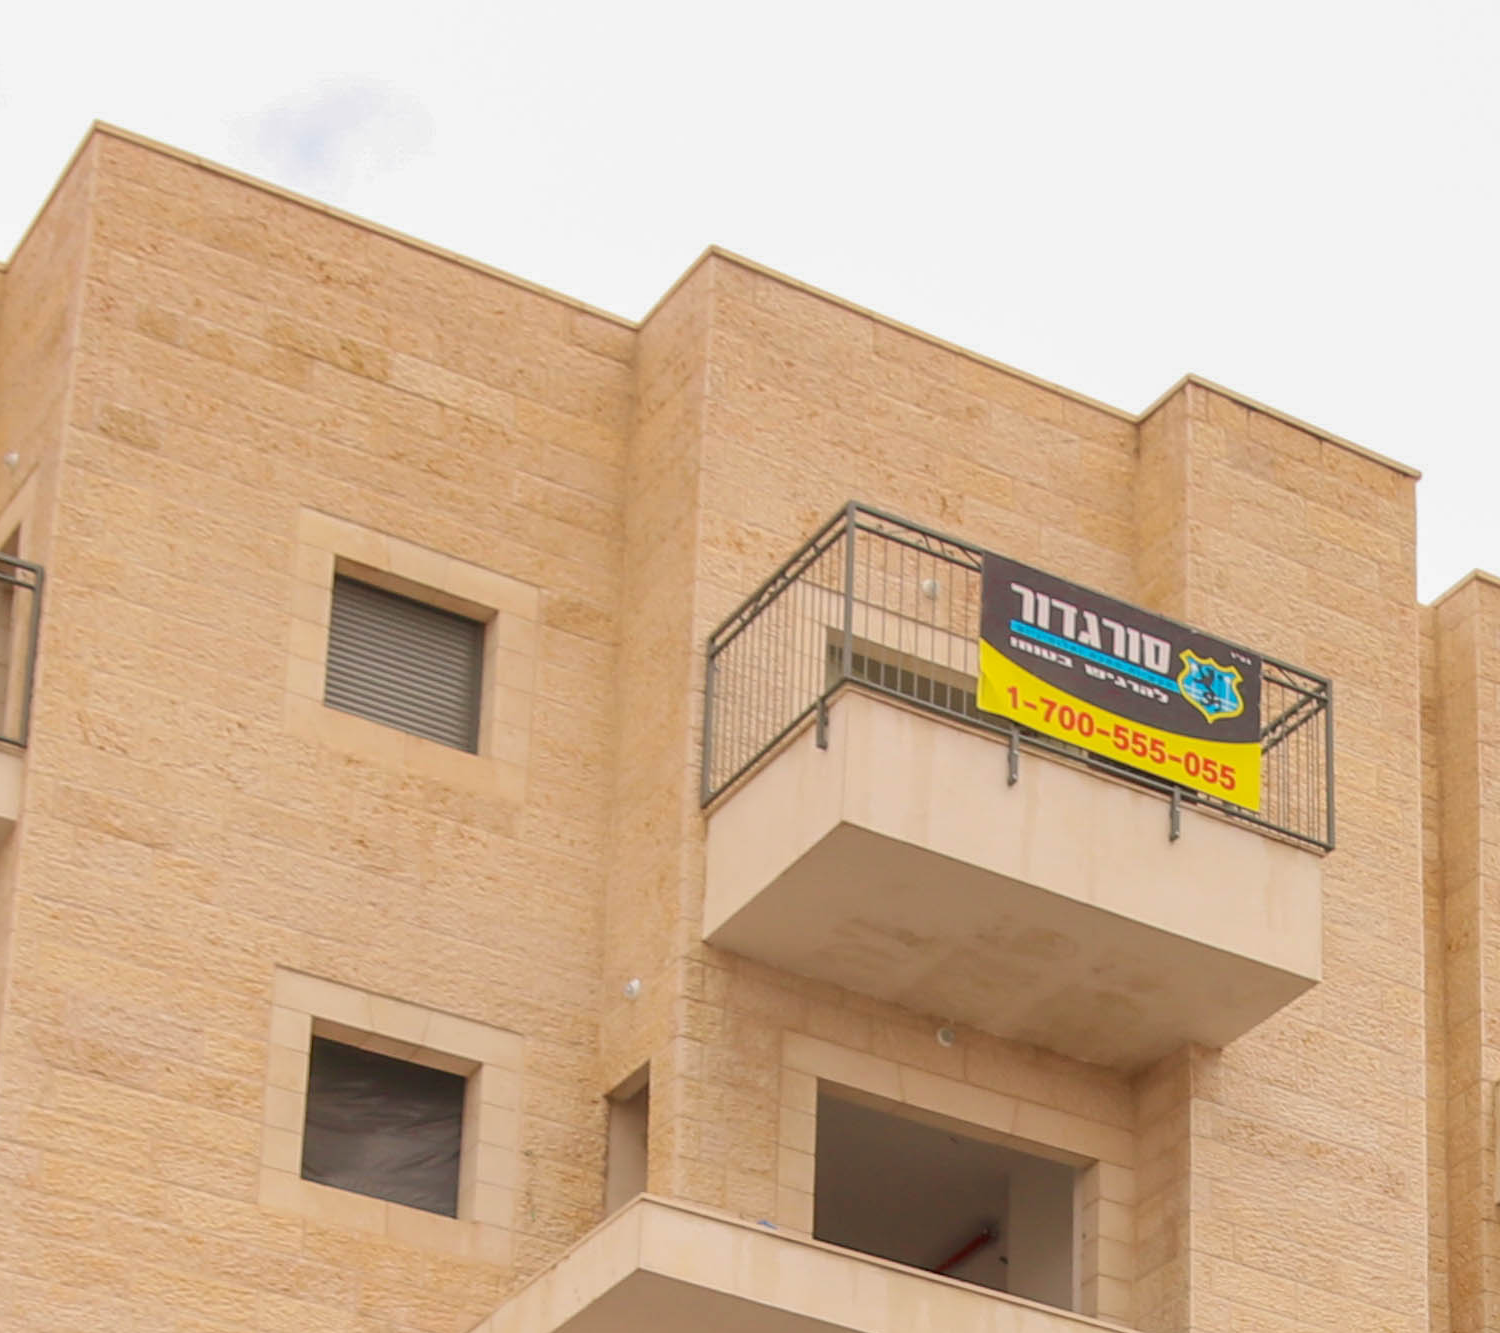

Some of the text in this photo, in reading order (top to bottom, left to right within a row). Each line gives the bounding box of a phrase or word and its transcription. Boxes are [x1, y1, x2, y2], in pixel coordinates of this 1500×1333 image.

[1010, 582, 1172, 675] סורגדור
[1084, 662, 1169, 704] להרגיש
[1007, 685, 1237, 791] 1-700-555-055
